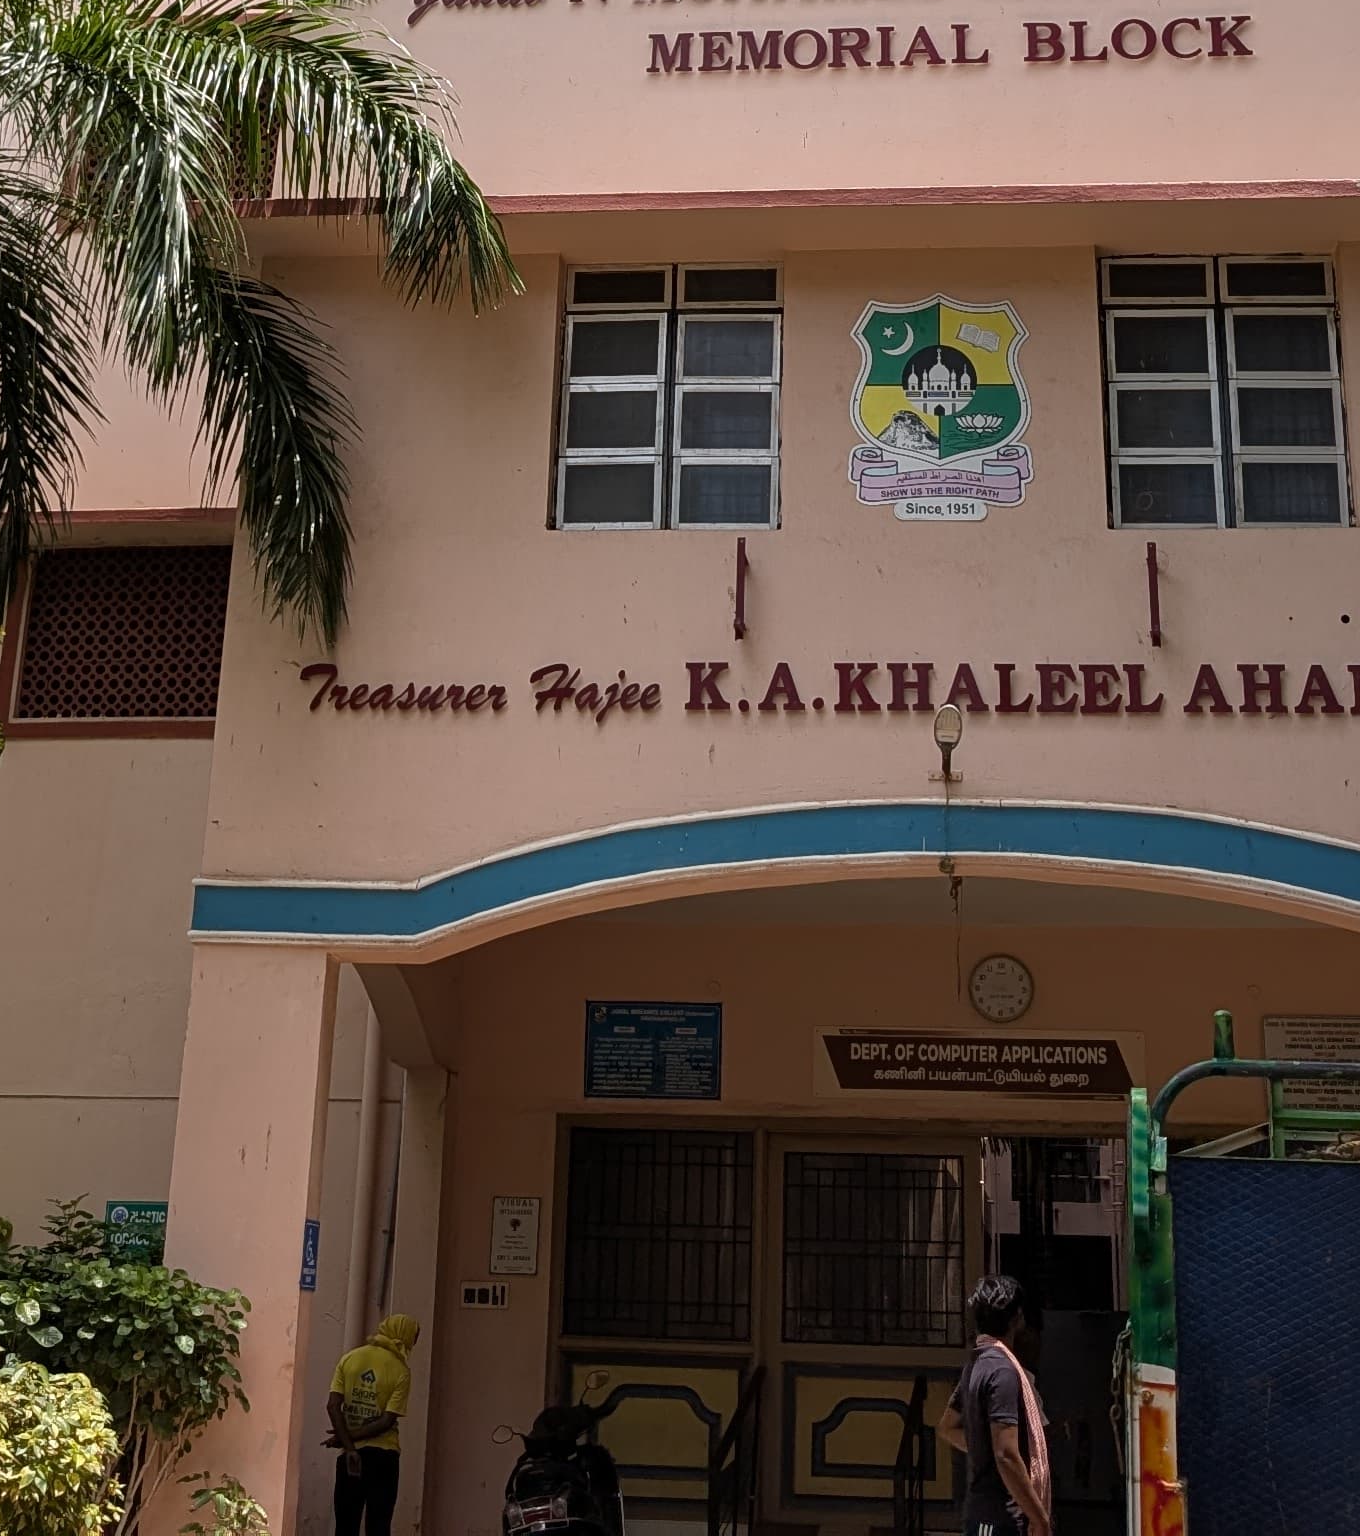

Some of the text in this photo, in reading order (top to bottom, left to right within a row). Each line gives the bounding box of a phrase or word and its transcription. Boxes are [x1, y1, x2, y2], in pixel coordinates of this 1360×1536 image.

[646, 15, 1254, 74] MEMORIAL BLOCK
[880, 486, 1000, 499] SHOW US THE RIGHT PATH
[946, 503, 975, 514] 1951
[300, 662, 508, 714] Treasurer
[529, 662, 662, 724] Hajee
[850, 1043, 1108, 1064] DEPT. OF COMPUTER APPLICATIONS
[873, 1066, 926, 1080] கணினி
[1049, 1072, 1089, 1088] துறை
